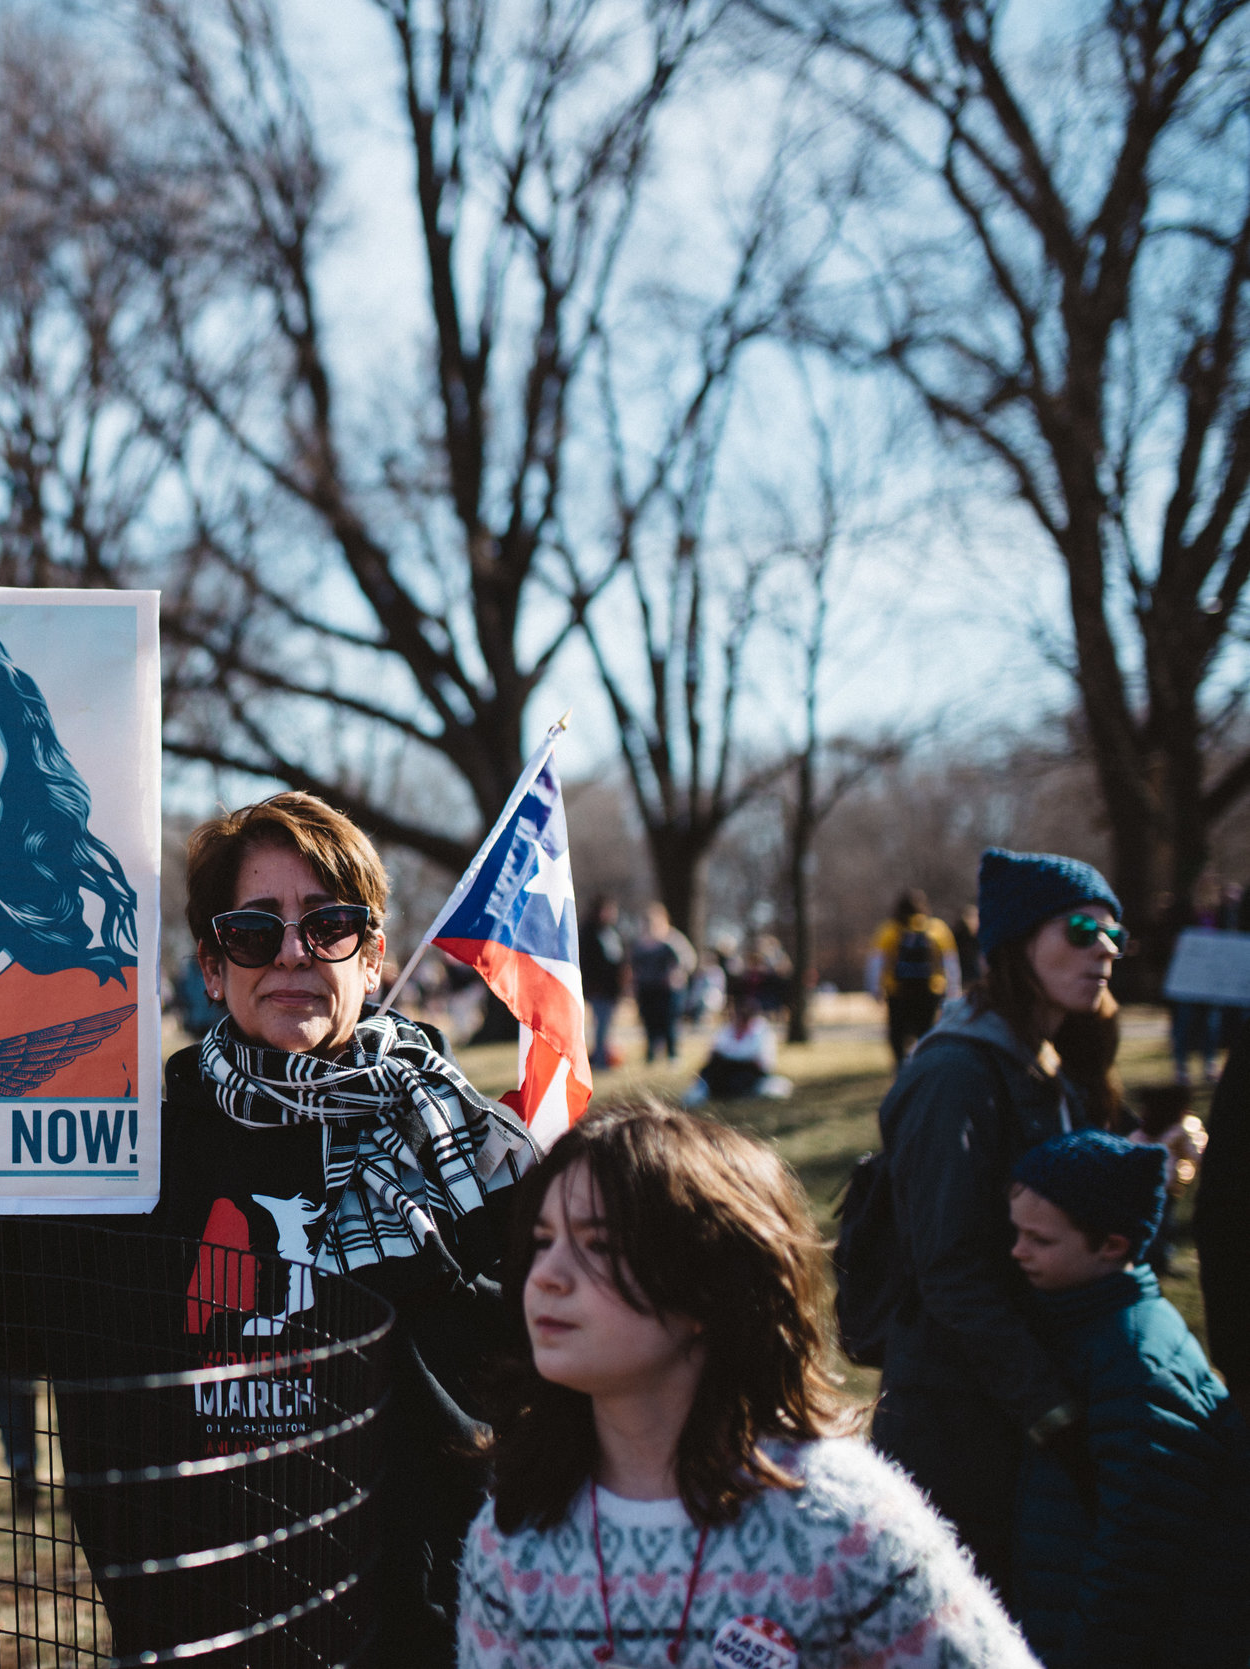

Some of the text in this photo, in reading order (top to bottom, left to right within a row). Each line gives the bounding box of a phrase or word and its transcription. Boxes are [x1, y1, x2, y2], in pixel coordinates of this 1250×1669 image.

[12, 1109, 138, 1164] NOW!
[194, 1378, 317, 1418] MARCH
[715, 1640, 769, 1669] WOM
[726, 1629, 791, 1668] NASTY
